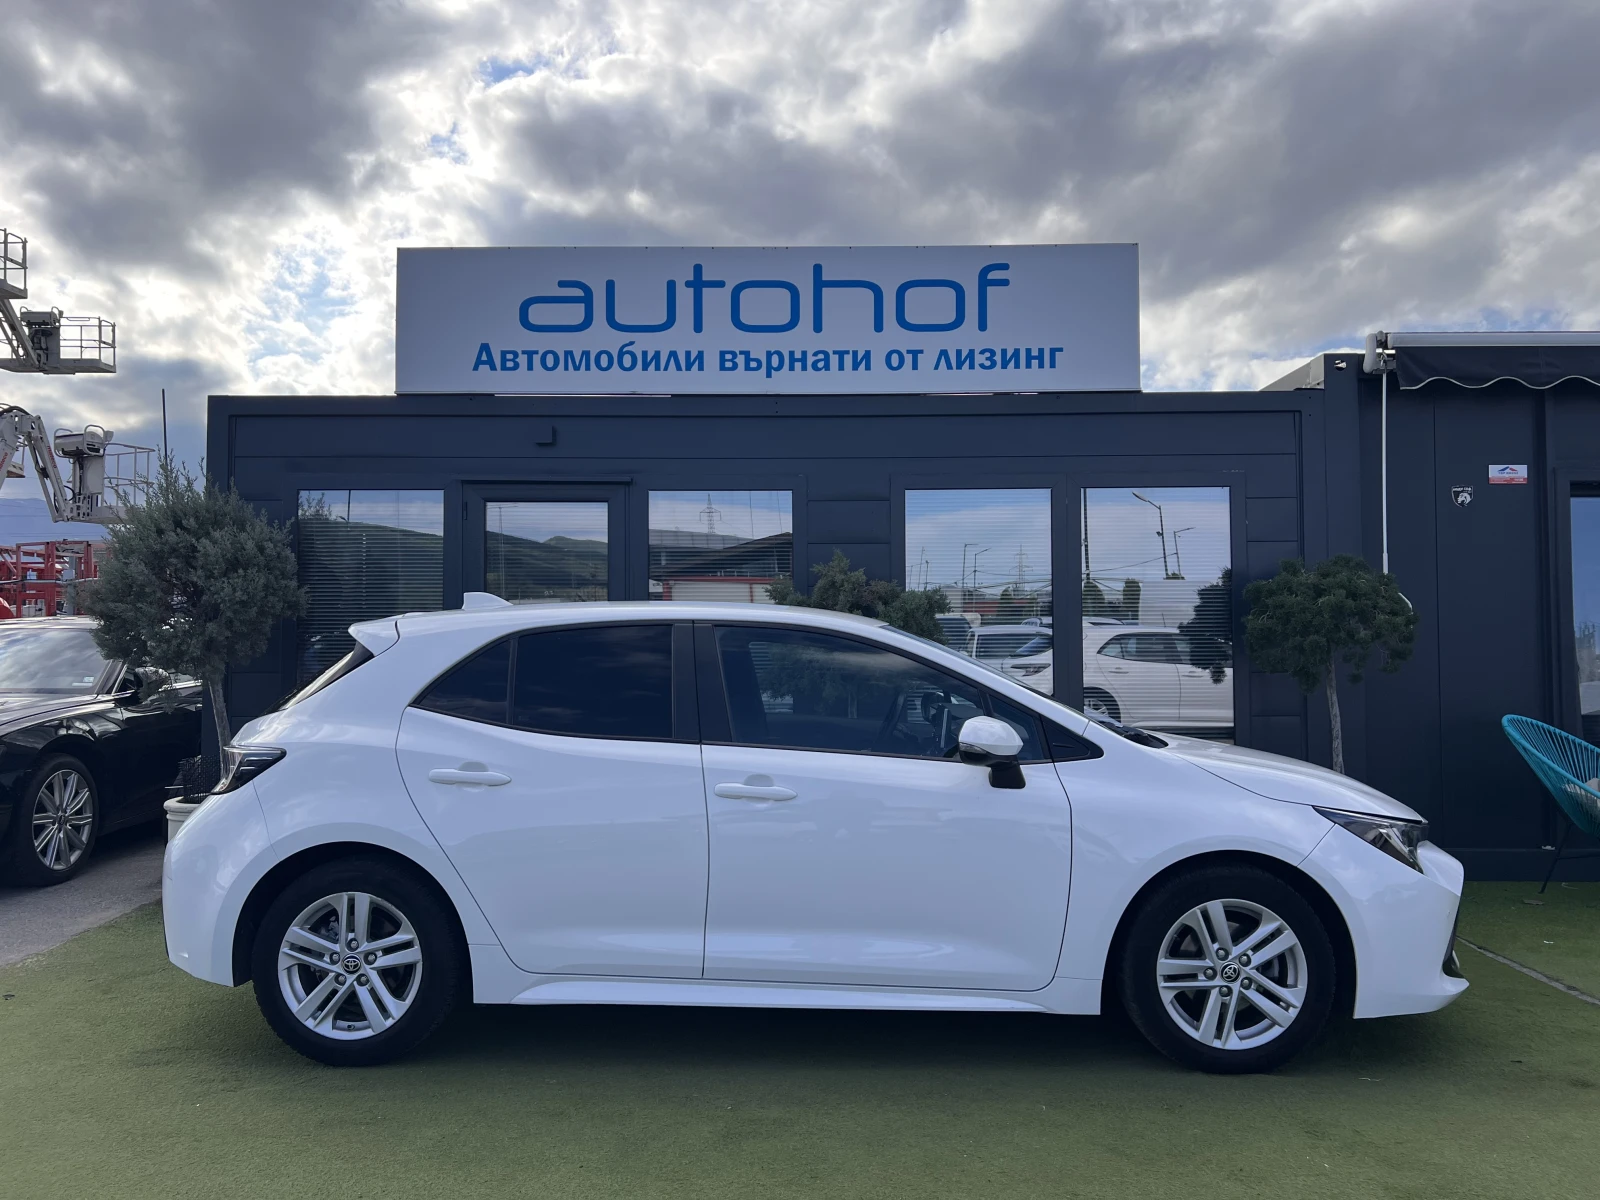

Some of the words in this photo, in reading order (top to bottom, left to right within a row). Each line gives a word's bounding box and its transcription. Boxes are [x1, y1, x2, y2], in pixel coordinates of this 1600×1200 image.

[519, 262, 1011, 334] autohof
[472, 340, 705, 372] Автомобили
[718, 349, 872, 379] върнати
[884, 348, 925, 372] от
[933, 346, 1064, 371] лизинг
